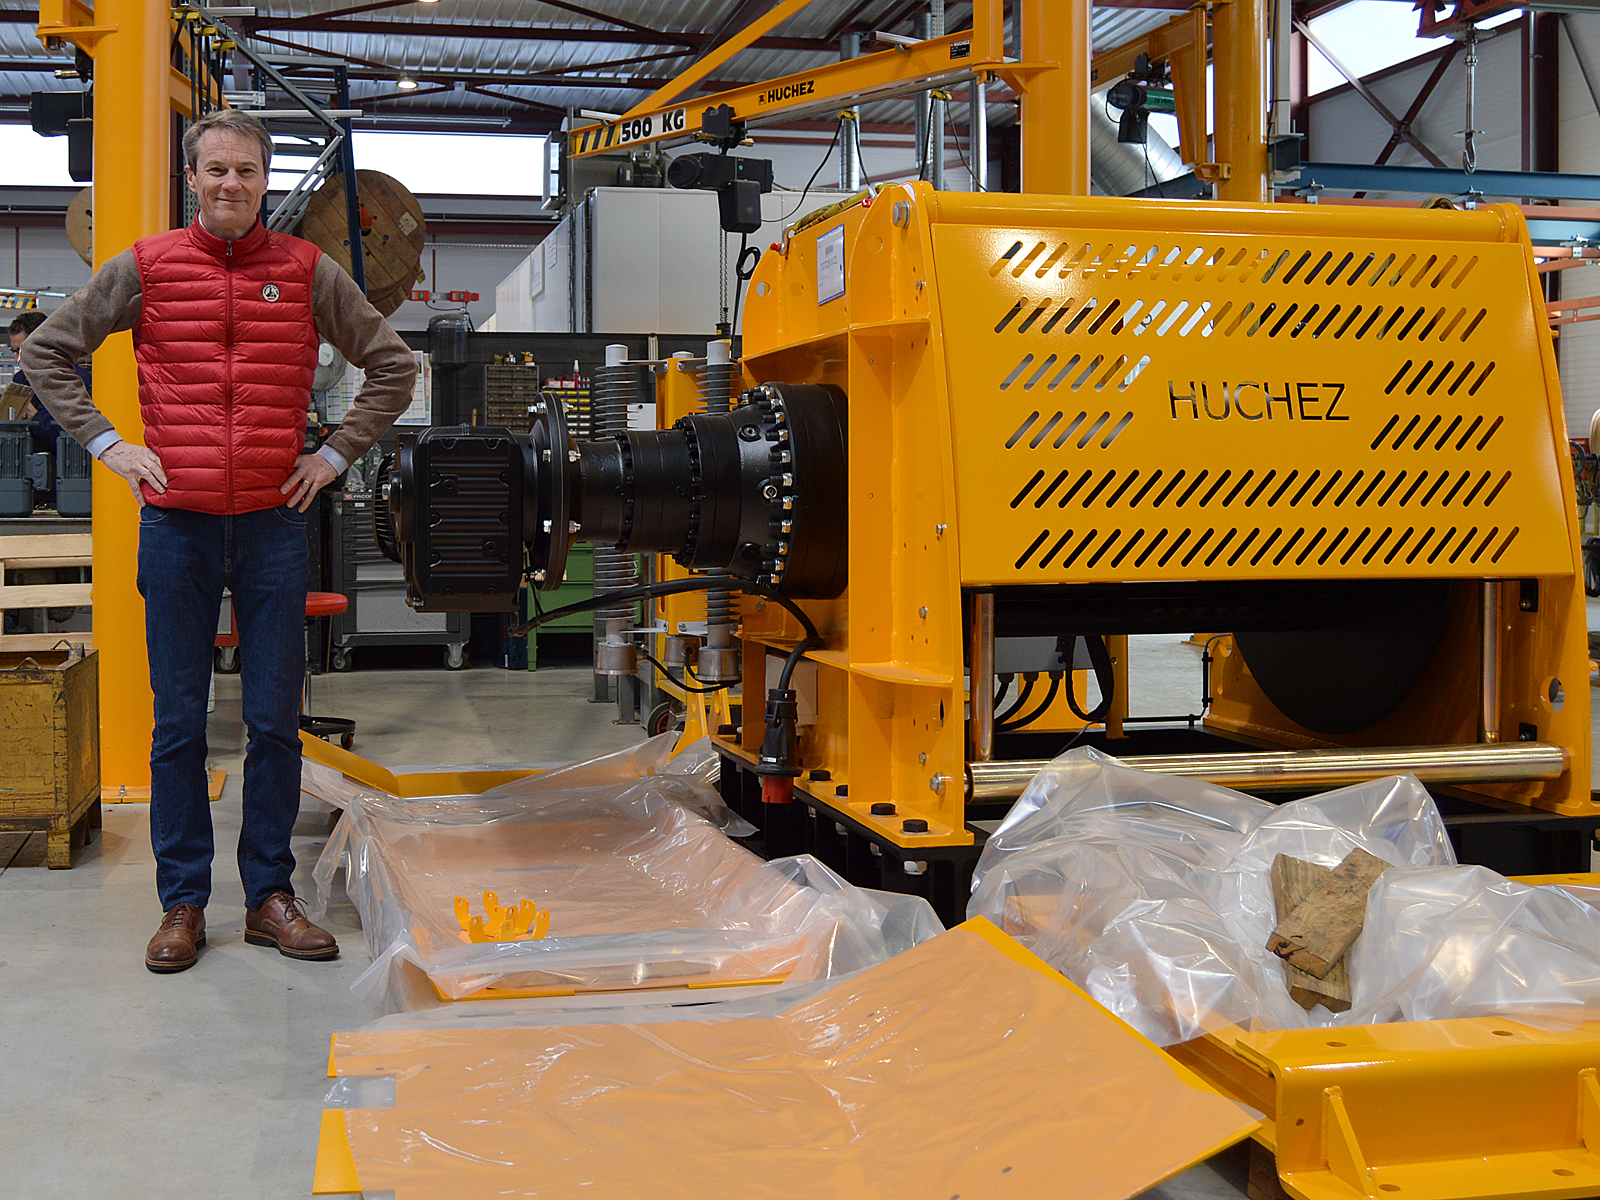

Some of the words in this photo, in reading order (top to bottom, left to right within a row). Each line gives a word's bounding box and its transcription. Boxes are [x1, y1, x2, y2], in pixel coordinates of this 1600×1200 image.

[768, 80, 815, 103] HUCHEZ
[621, 117, 653, 142] 500
[662, 108, 684, 133] KG
[1168, 381, 1350, 421] HUCHEZ
